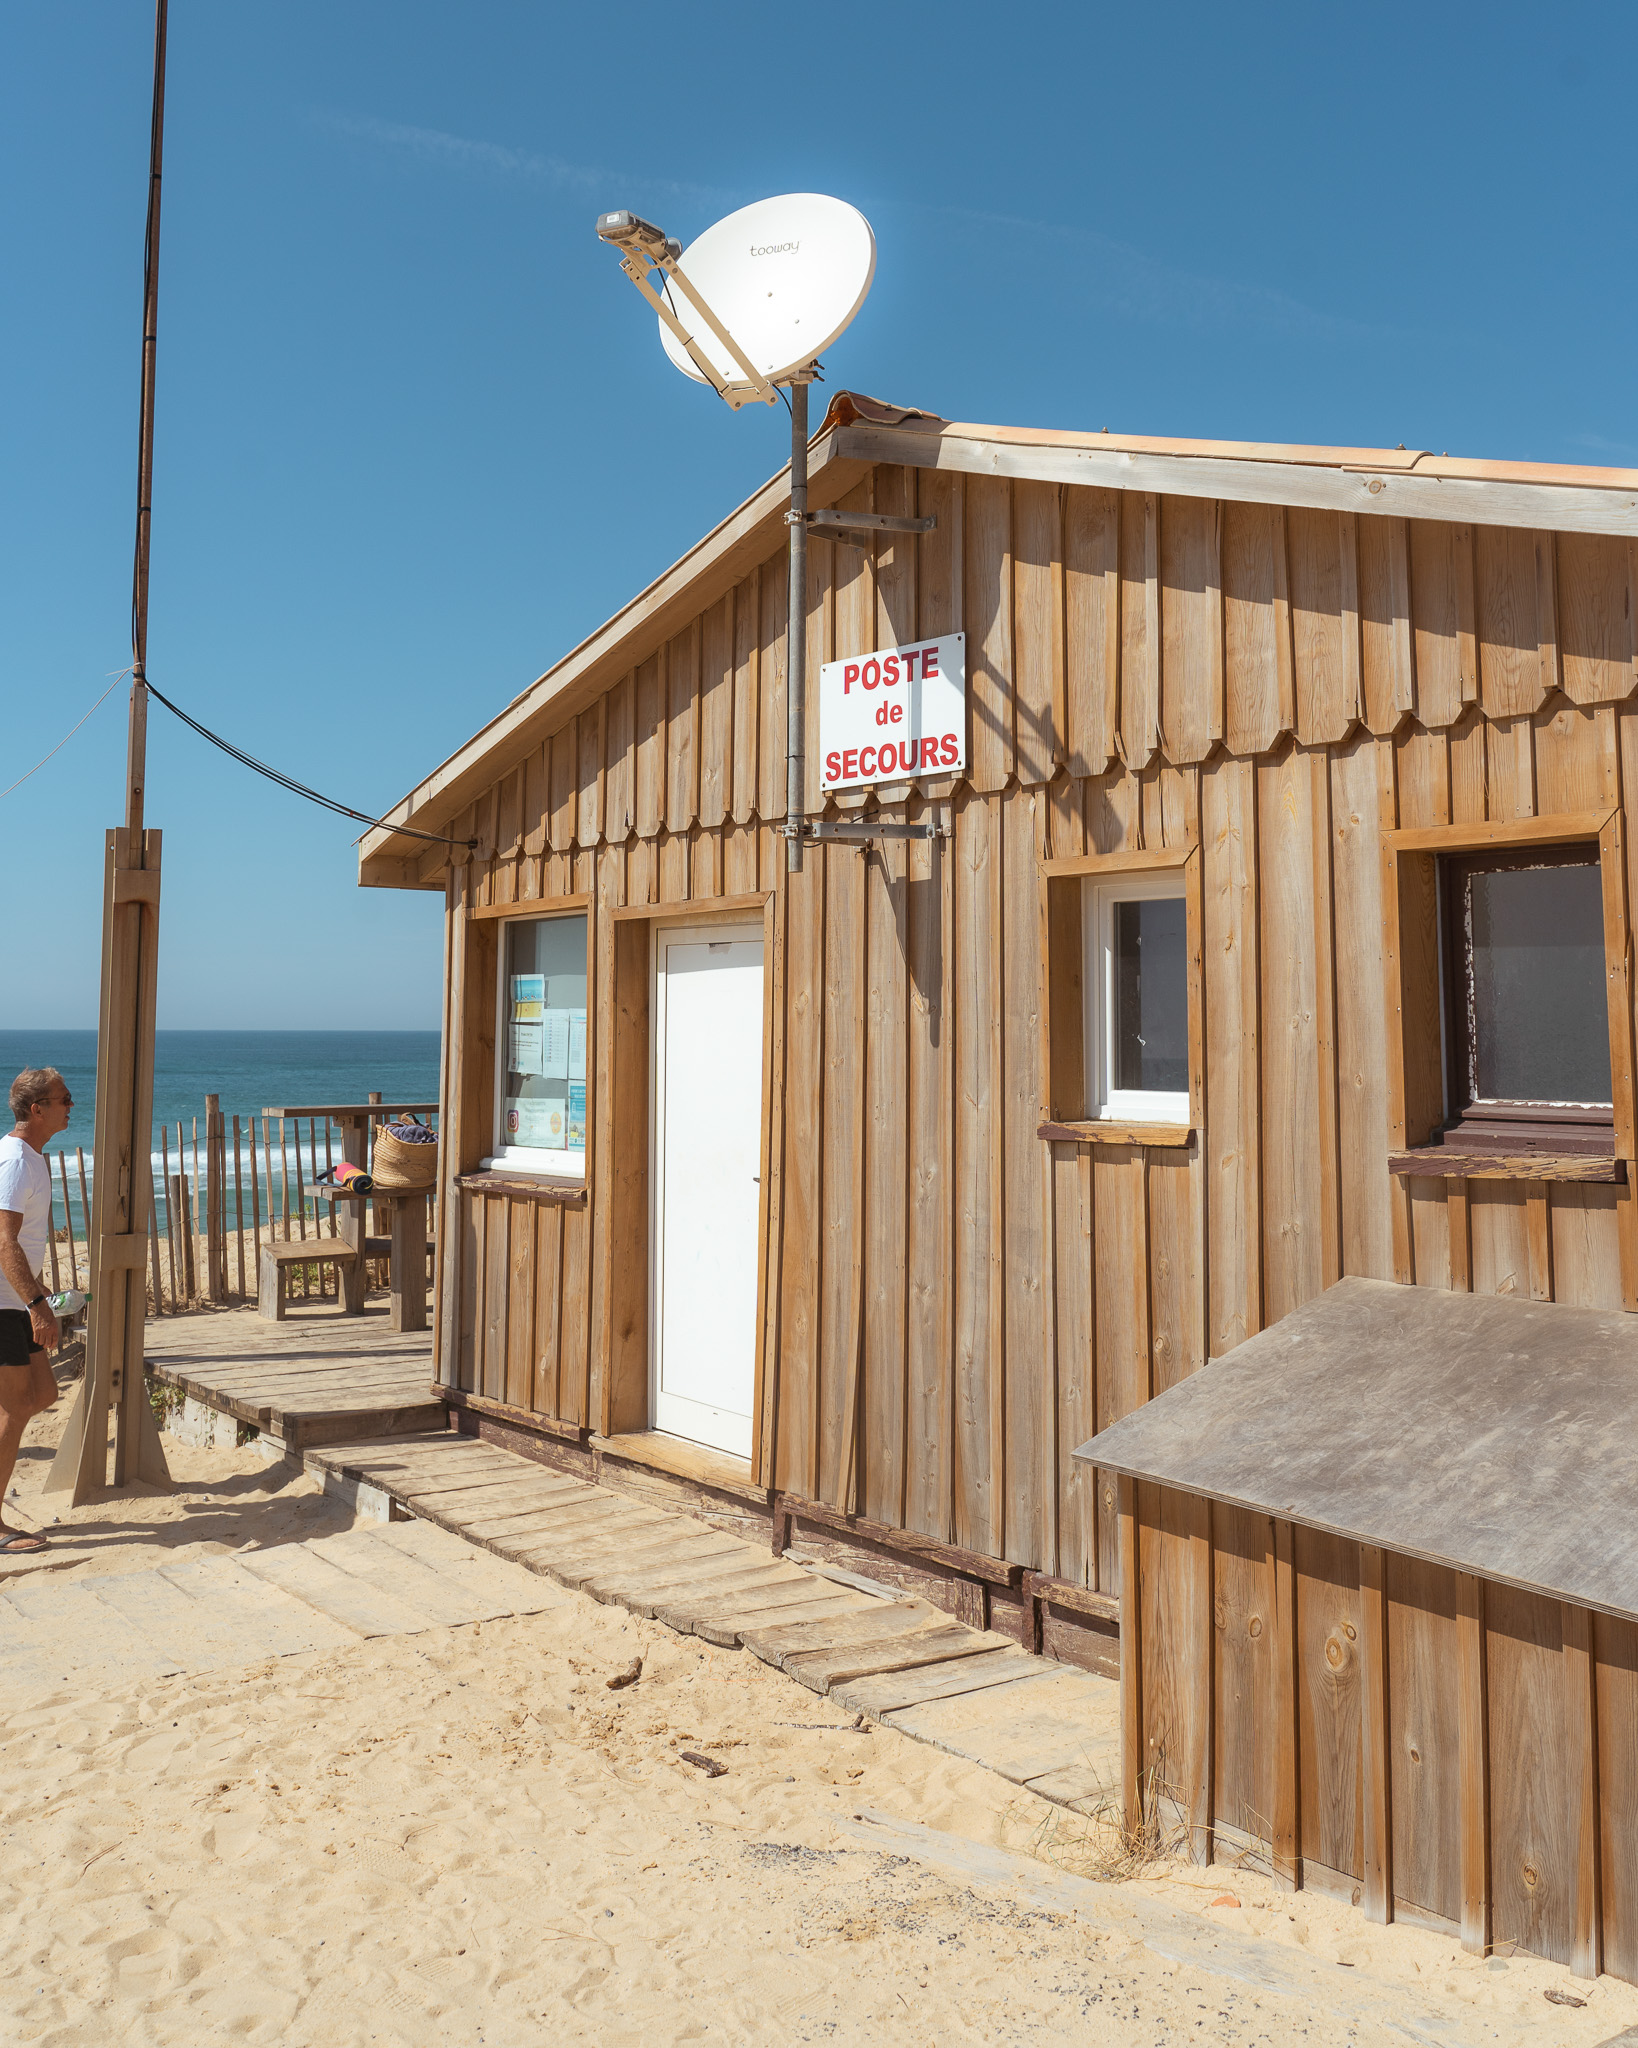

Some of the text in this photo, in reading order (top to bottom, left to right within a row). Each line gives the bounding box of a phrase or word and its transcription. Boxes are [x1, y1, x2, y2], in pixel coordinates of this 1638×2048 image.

[750, 241, 799, 256] tooway
[844, 646, 939, 695] POSTE
[875, 700, 903, 726] de
[825, 733, 959, 782] SECOURS
